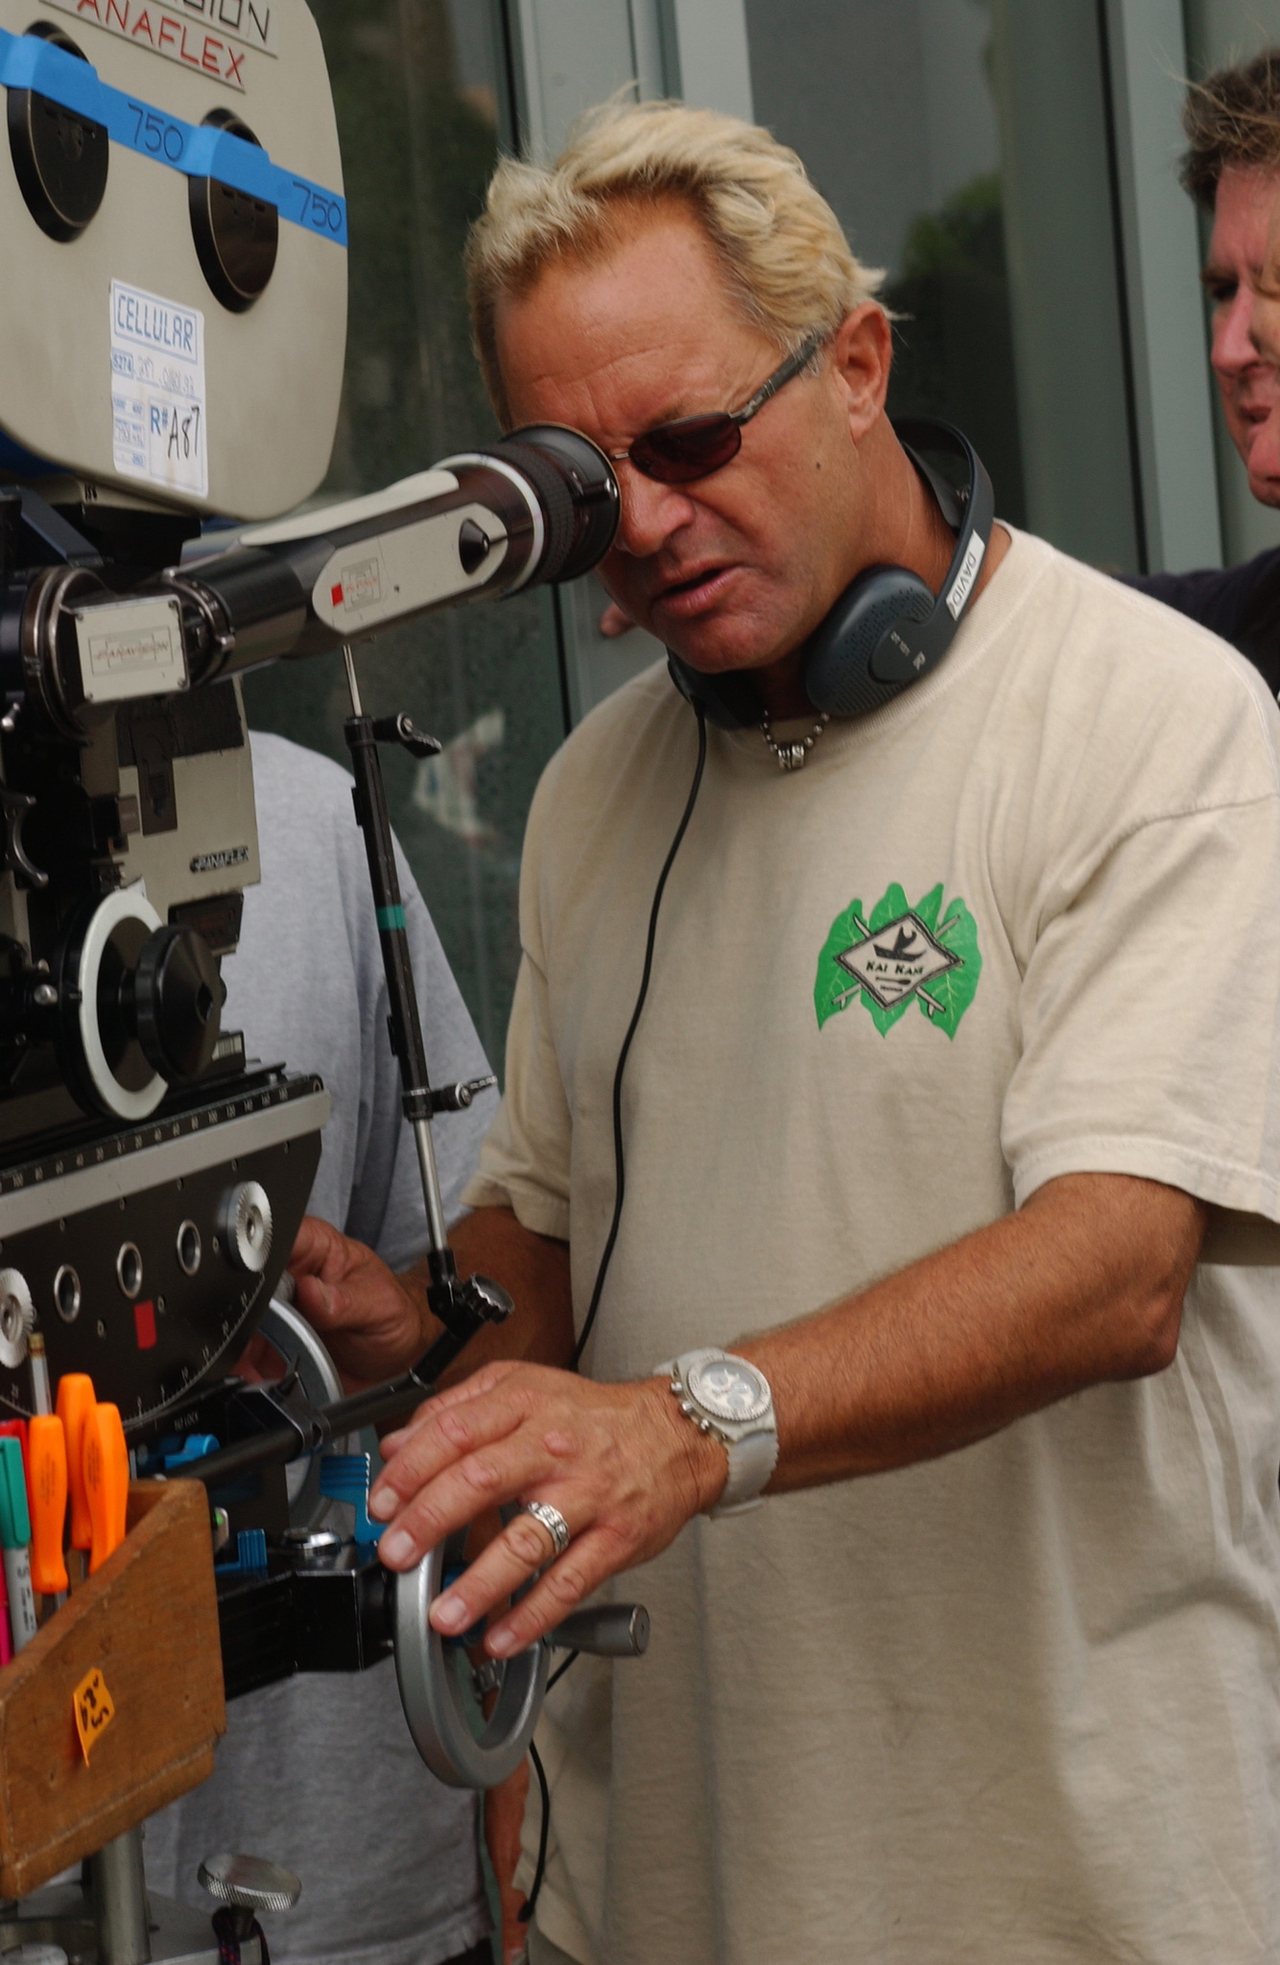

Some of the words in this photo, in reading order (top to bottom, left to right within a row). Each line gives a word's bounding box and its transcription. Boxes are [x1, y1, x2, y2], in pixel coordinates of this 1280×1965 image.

[127, 102, 184, 163] 750
[292, 180, 343, 233] 750
[116, 295, 193, 353] CELLULAR
[952, 550, 977, 607] DAVID
